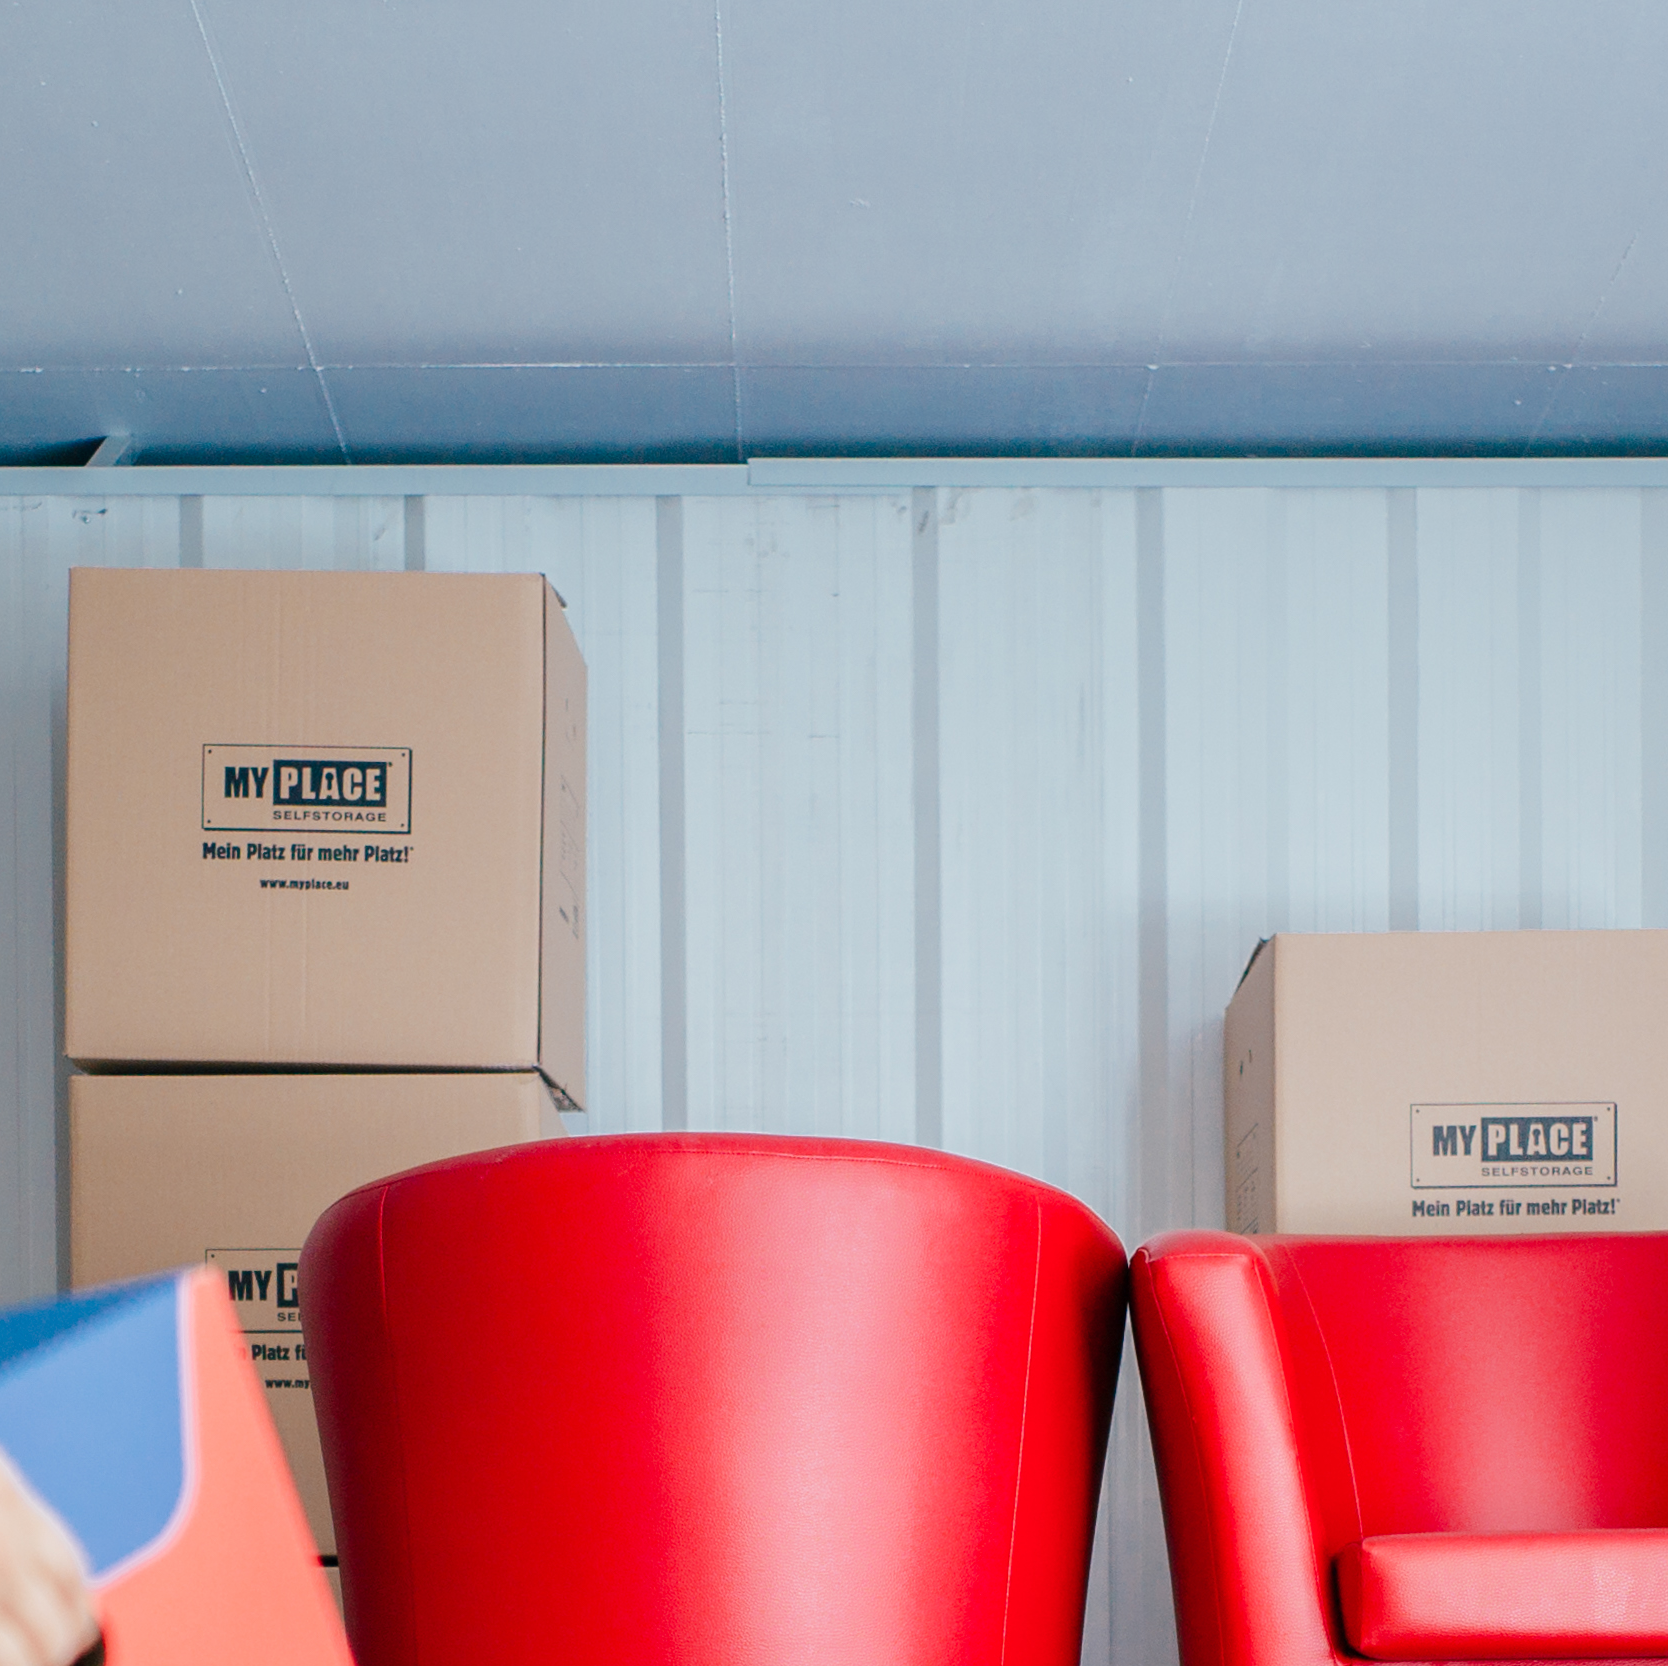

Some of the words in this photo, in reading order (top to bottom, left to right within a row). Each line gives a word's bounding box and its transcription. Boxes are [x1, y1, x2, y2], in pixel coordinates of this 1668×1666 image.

[224, 766, 269, 798] MY
[279, 765, 382, 801] PLACE
[272, 810, 387, 822] SELFSTORAGE
[202, 842, 241, 860] Mein
[246, 843, 286, 861] Platz
[290, 844, 314, 861] für
[318, 845, 360, 862] mehr
[364, 845, 409, 863] Platz!
[260, 878, 349, 890] www.myplace.eu
[1432, 1124, 1477, 1157] MY
[1487, 1122, 1588, 1157] PLACE
[1481, 1166, 1593, 1177] SELFSTORAGE
[1411, 1200, 1450, 1217] Mein
[1455, 1200, 1494, 1216] Platz
[1499, 1199, 1521, 1216] für
[1526, 1199, 1567, 1215] mehr
[1572, 1198, 1616, 1215] Platz!
[228, 1270, 272, 1301] MY
[251, 1344, 290, 1361] Platz
